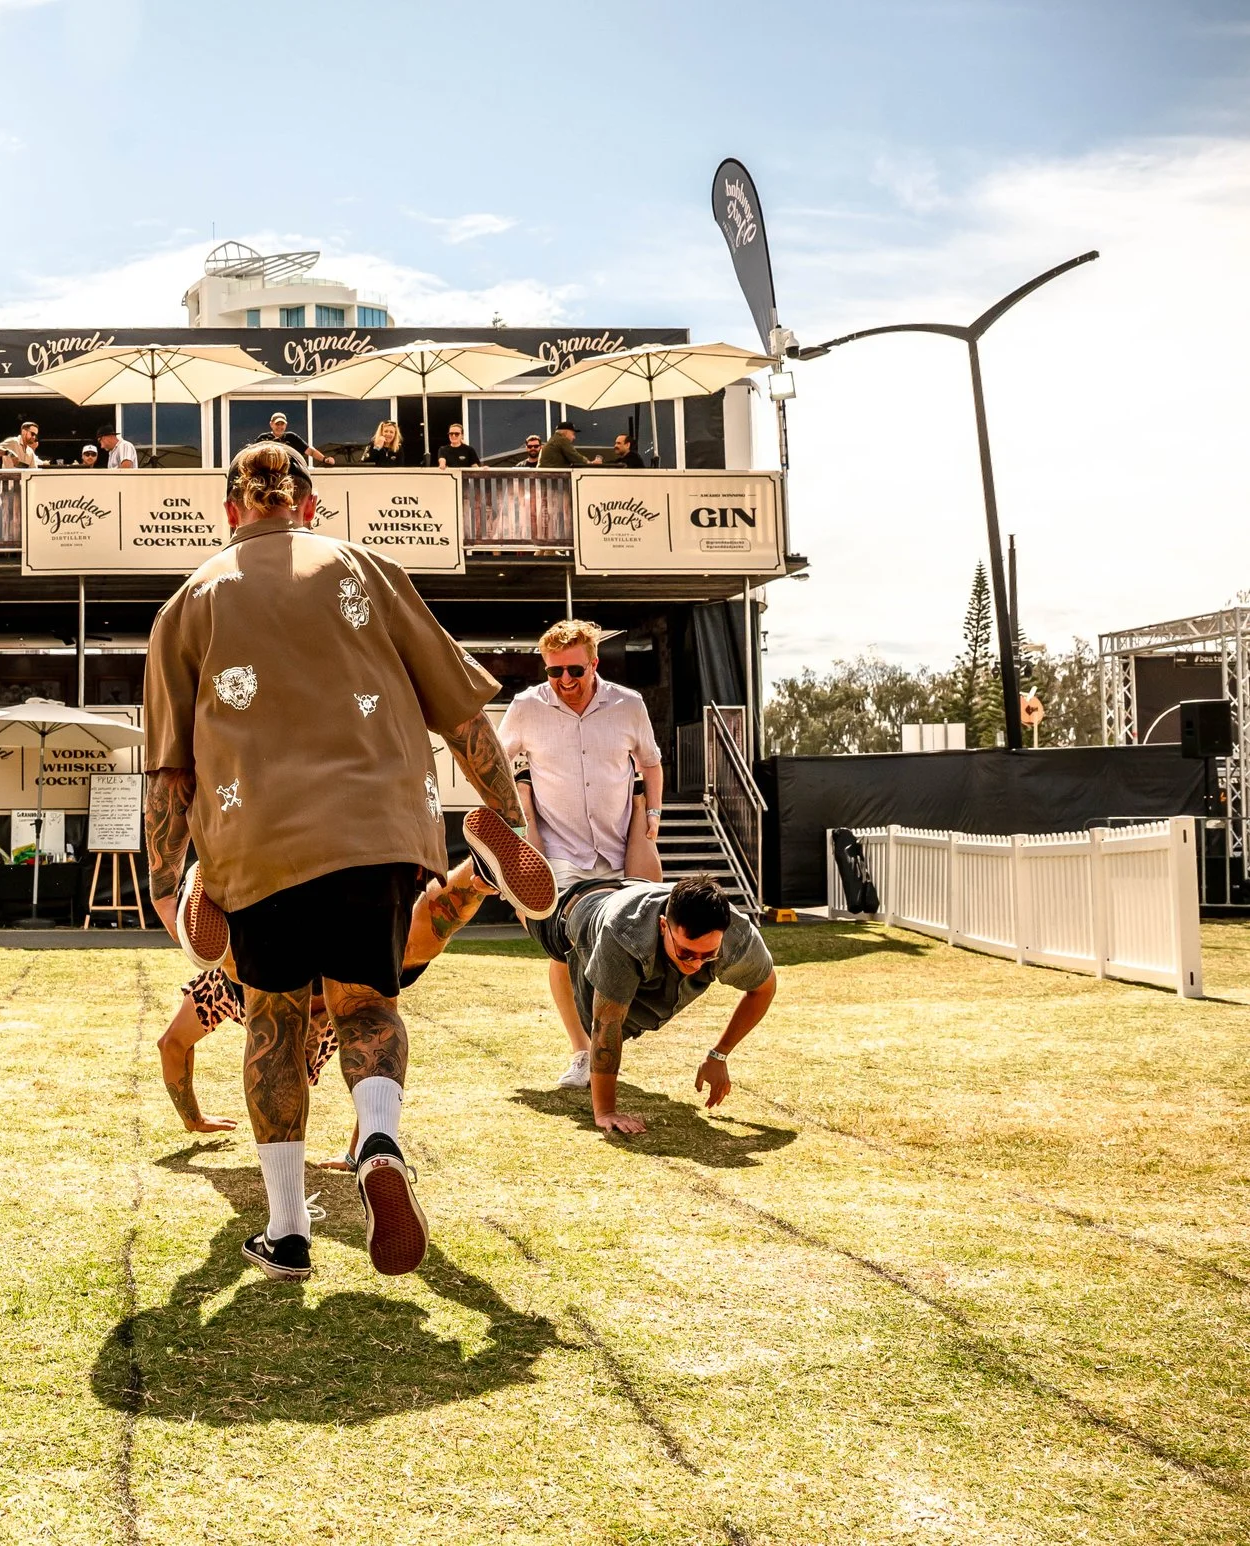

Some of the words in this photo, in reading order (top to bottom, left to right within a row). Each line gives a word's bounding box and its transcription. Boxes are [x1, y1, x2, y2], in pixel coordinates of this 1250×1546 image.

[162, 498, 191, 507] GIN
[391, 496, 419, 505] GIN
[36, 495, 112, 526] Granddad
[378, 510, 433, 518] VODKA
[587, 496, 660, 526] Granddad
[150, 512, 205, 520] VODKA
[690, 507, 757, 528] GIN
[50, 511, 94, 534] Jack's
[368, 522, 444, 532] WHISKEY
[602, 512, 644, 535] Jack's
[139, 524, 216, 534] WHISKEY
[132, 537, 223, 547] COCKTAILS
[362, 536, 450, 546] COCKTAILS
[52, 750, 107, 758] VODKA
[42, 763, 117, 772] WHISKEY
[97, 776, 124, 784] PRIZES
